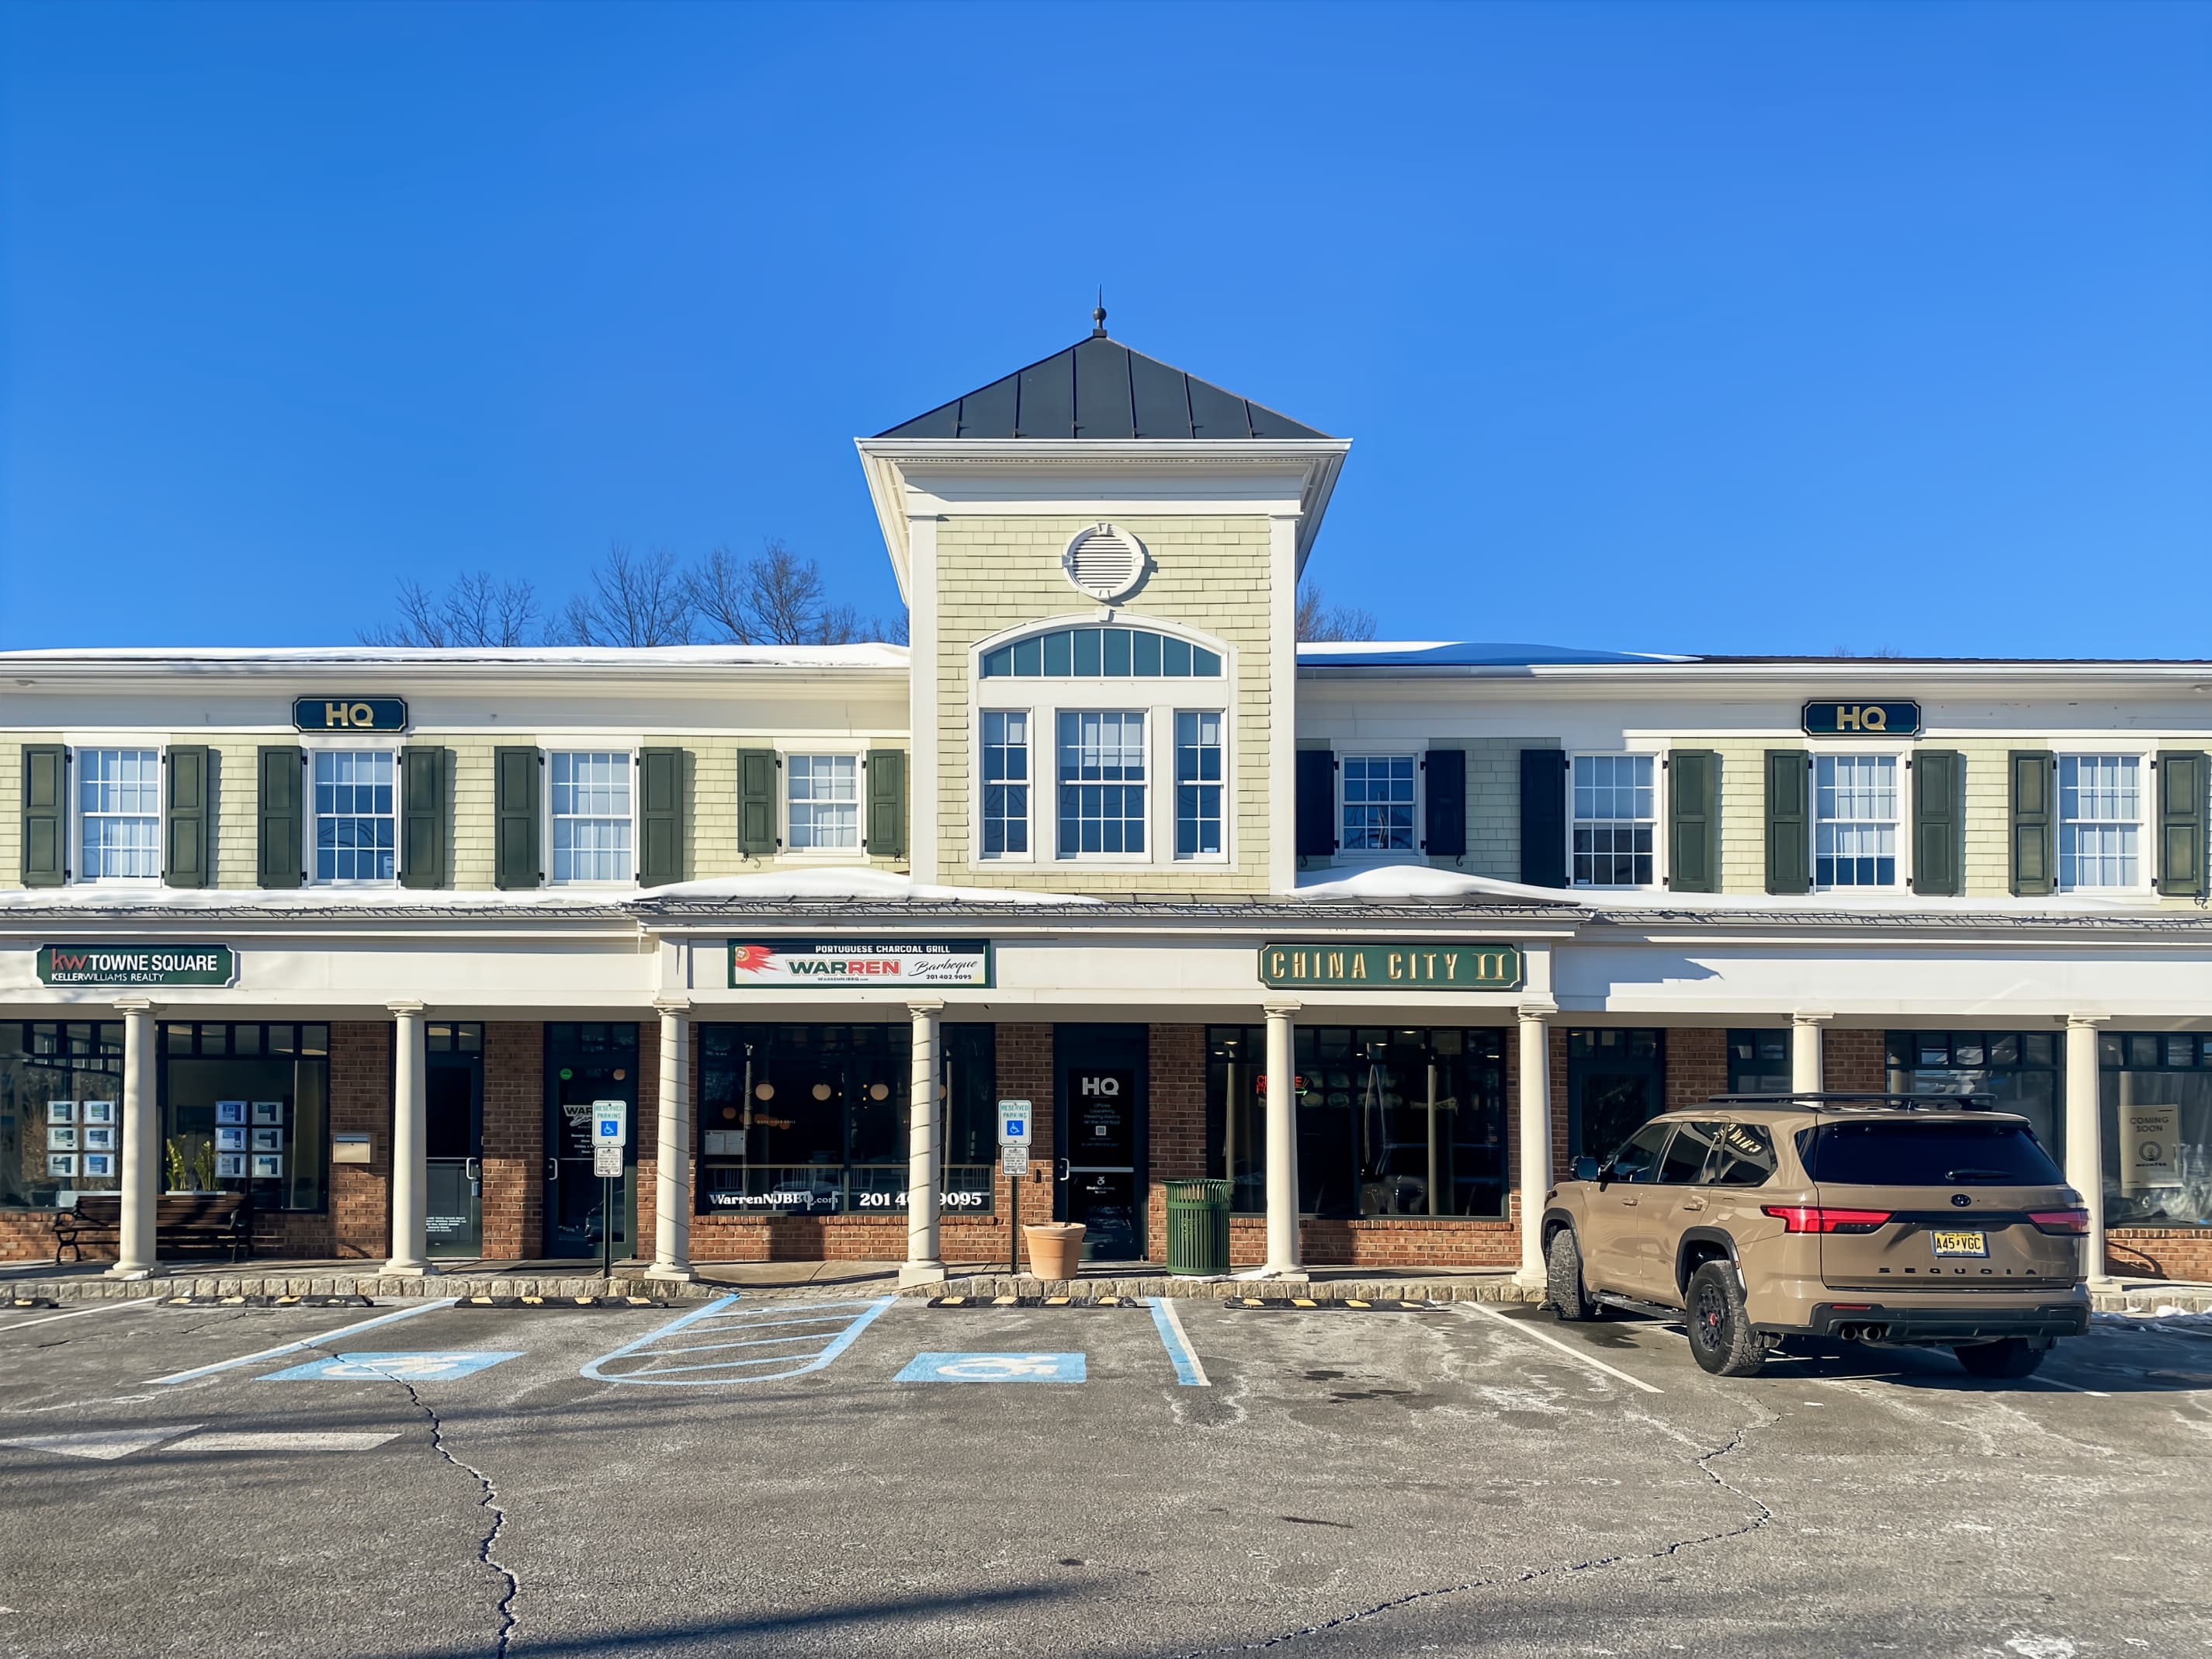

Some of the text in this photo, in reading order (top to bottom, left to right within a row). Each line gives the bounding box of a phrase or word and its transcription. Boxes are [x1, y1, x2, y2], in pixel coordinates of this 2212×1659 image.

[326, 703, 373, 726] HQ
[1837, 706, 1887, 731] HQ
[51, 948, 218, 972] kw TOWNE SQUARE
[786, 959, 901, 975] WARREN
[908, 958, 979, 976] Barbeque
[1271, 951, 1509, 980] CHINA CITY II
[130, 973, 165, 982] REALTY
[1082, 1078, 1119, 1095] HQ
[709, 1193, 838, 1204] WarrenNJBBQ.com
[859, 1193, 890, 1207] 201
[940, 1192, 982, 1206] 9095
[1936, 1238, 1981, 1249] A45 VGC
